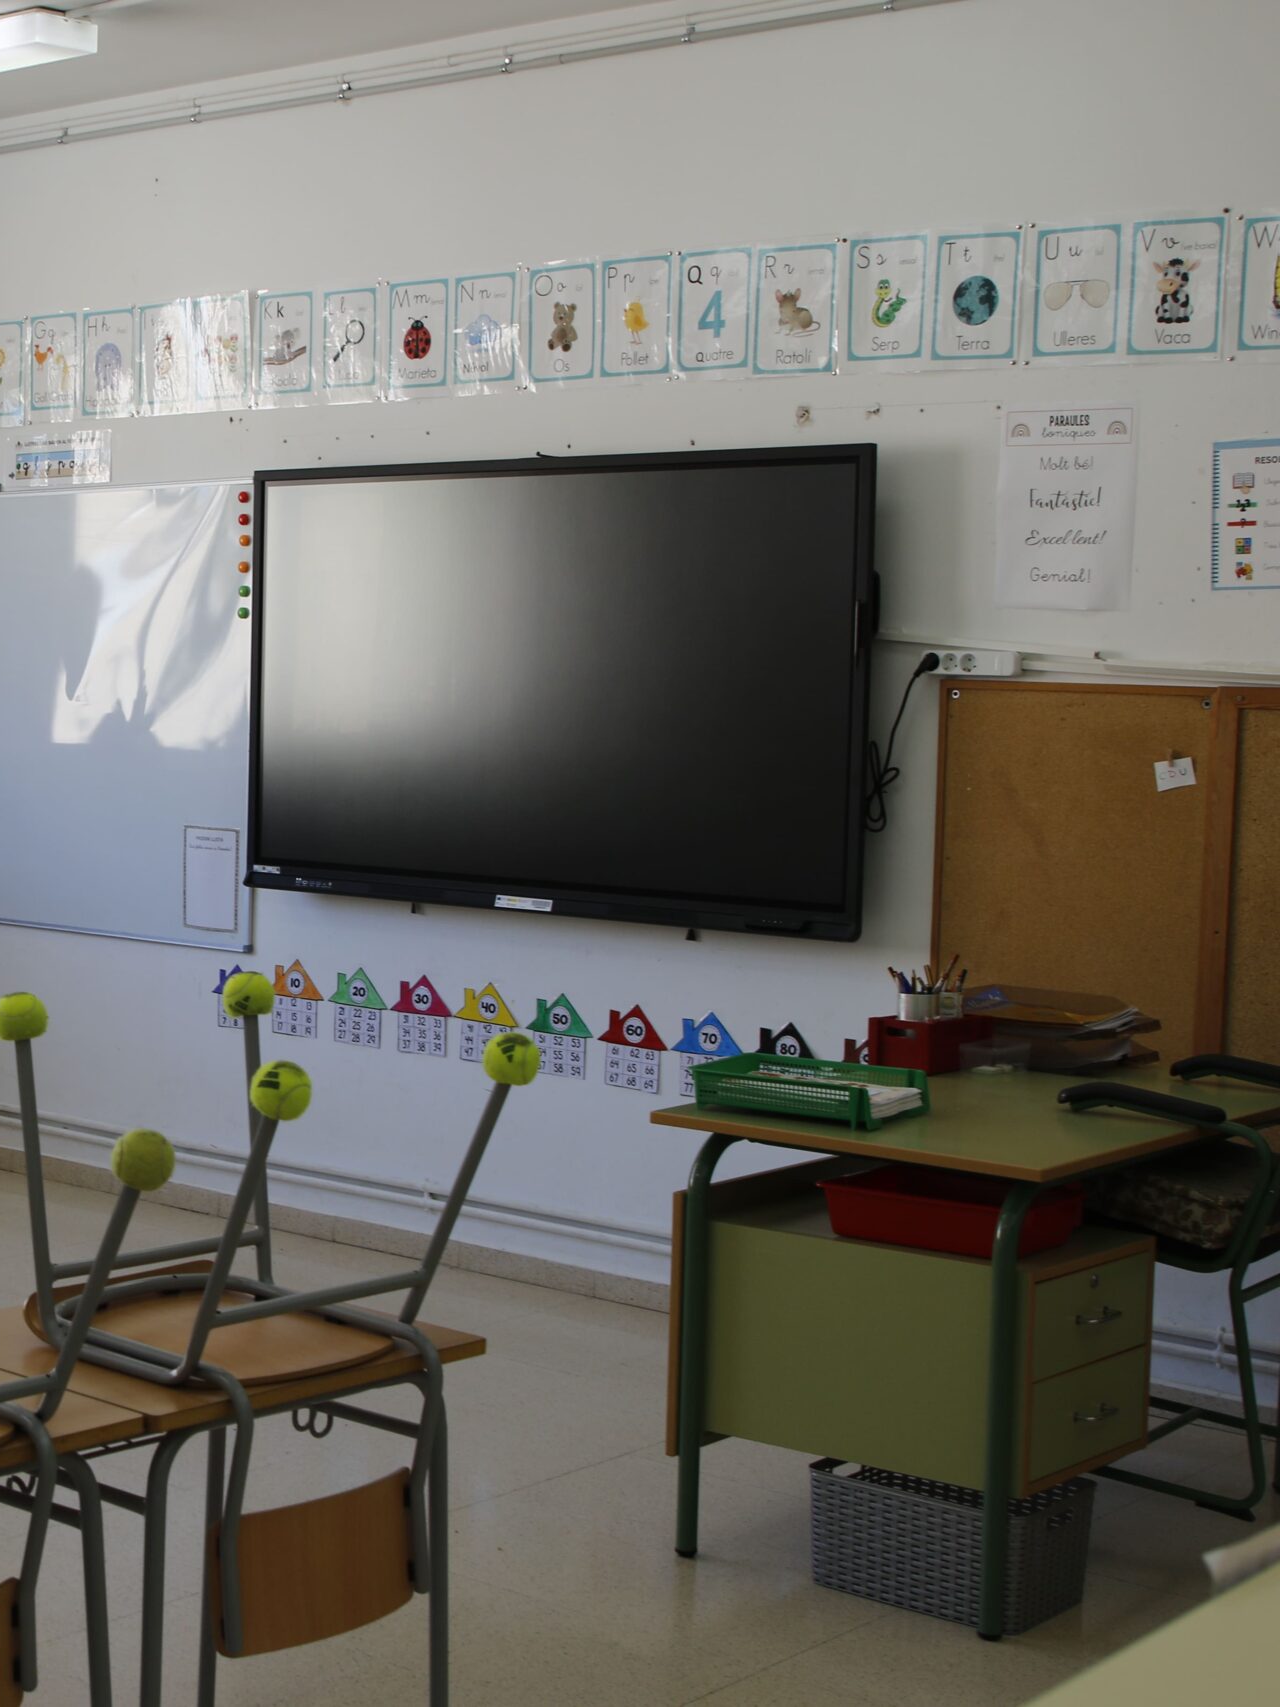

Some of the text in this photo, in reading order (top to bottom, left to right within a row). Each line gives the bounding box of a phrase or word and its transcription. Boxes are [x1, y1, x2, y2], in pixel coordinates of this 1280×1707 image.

[1140, 228, 1155, 251] V
[1252, 224, 1279, 248] W
[945, 242, 957, 265] T
[963, 246, 972, 262] t
[1044, 236, 1059, 260] U
[1068, 246, 1082, 257] u
[856, 245, 870, 269] S
[764, 255, 777, 279] R
[607, 266, 618, 289] P
[687, 265, 703, 285] Q
[460, 282, 474, 303] N
[534, 274, 554, 297] O
[392, 288, 410, 309] M
[264, 300, 273, 320] K
[697, 289, 726, 338] 4
[34, 320, 47, 340] G
[87, 318, 98, 337] H
[955, 335, 991, 351] Terra
[1053, 330, 1096, 347] Ulleres
[1154, 328, 1191, 345] Vaca
[871, 336, 901, 353] Serp
[553, 358, 570, 373] Os
[621, 351, 649, 366] Pollet
[398, 367, 437, 380] Marieta
[1049, 414, 1090, 427] PARAULES
[1039, 456, 1070, 471] Molt
[1254, 455, 1280, 464] RESO
[1030, 566, 1091, 583] Genial!
[291, 978, 301, 988] 10
[352, 986, 366, 997] 20
[414, 993, 429, 1005] 30
[353, 1008, 362, 1018] 22
[368, 1011, 377, 1021] 23
[481, 1002, 496, 1014] 40
[352, 1020, 361, 1031] 25
[366, 1022, 376, 1033] 26
[417, 1016, 426, 1026] 32
[433, 1018, 442, 1028] 33
[552, 1013, 568, 1025] 50
[337, 1029, 376, 1044] 27 28 29
[417, 1029, 427, 1039] 35
[433, 1030, 442, 1041] 36
[482, 1024, 492, 1034] 42
[626, 1024, 644, 1037] 60
[402, 1039, 411, 1049] 37
[417, 1041, 426, 1052] 38
[553, 1036, 564, 1046] 52
[571, 1038, 581, 1049] 53
[701, 1032, 718, 1045] 70
[553, 1050, 563, 1060] 55
[570, 1052, 580, 1062] 56
[629, 1048, 641, 1059] 62
[645, 1051, 655, 1061] 63
[780, 1043, 797, 1056] 80
[553, 1063, 563, 1073] 58
[609, 1059, 655, 1075] 64 65 66
[609, 1072, 654, 1089] 67 68 69
[684, 1082, 694, 1093] 77
